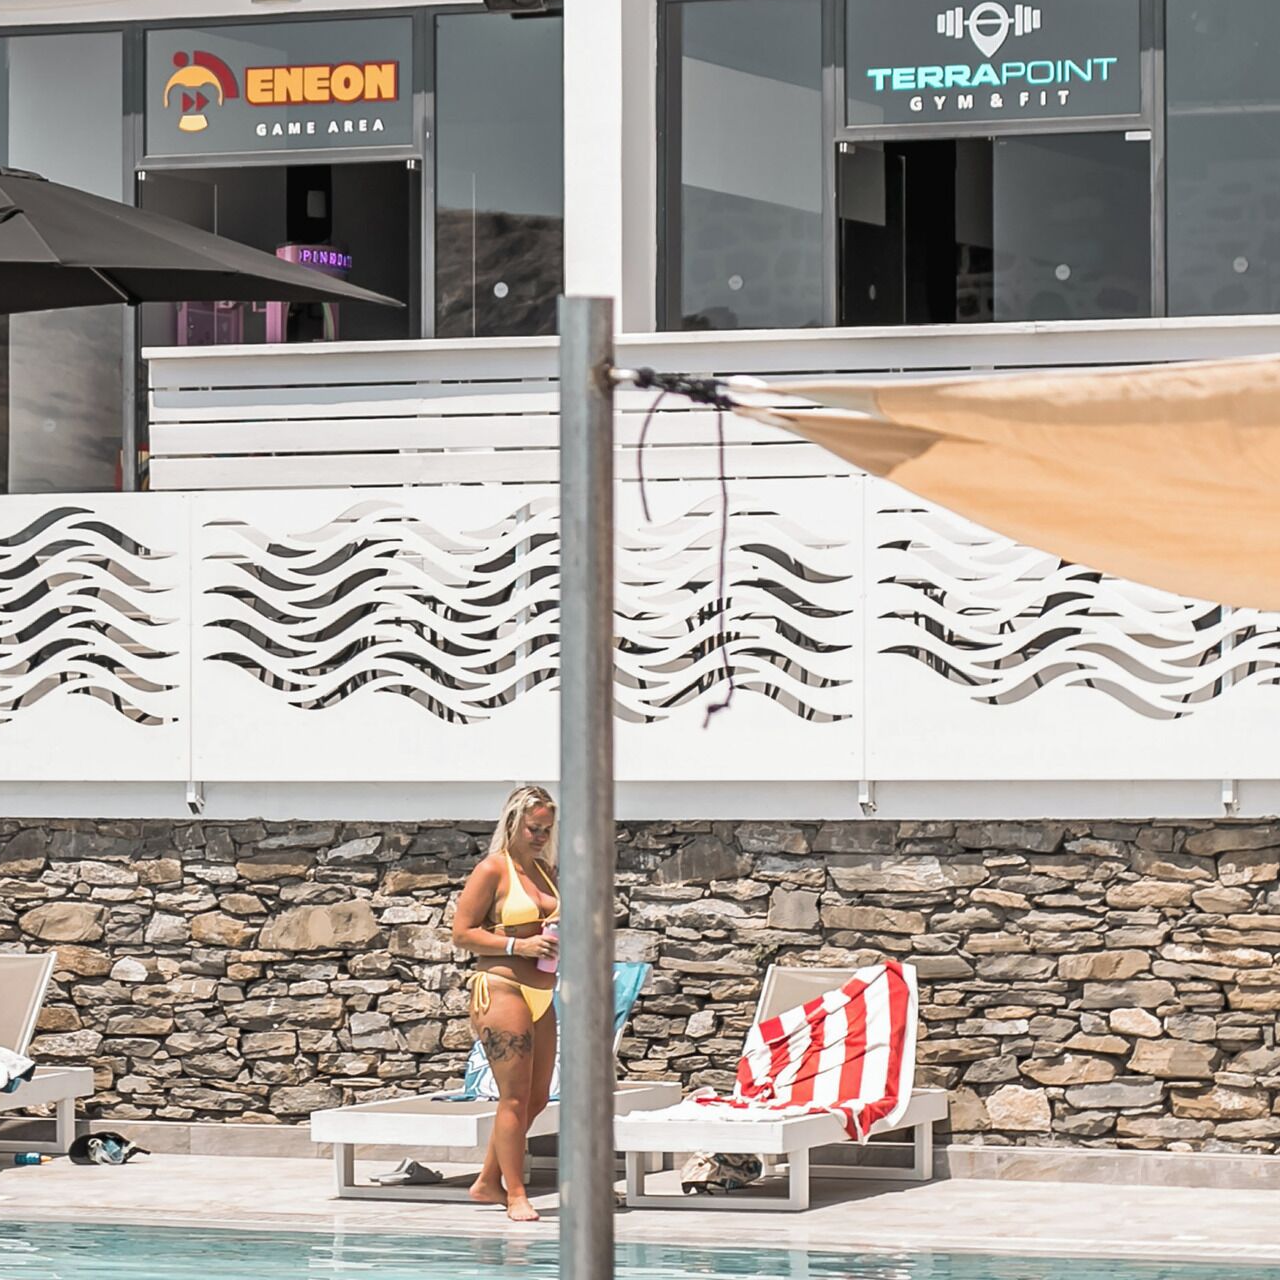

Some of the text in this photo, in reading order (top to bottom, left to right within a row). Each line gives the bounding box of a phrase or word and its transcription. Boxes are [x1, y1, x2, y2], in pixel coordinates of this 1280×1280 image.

[245, 60, 399, 106] ENEON
[867, 57, 1118, 91] TERRAPOINT
[909, 90, 1070, 111] GYM & FIT
[255, 119, 384, 136] GAME AREA
